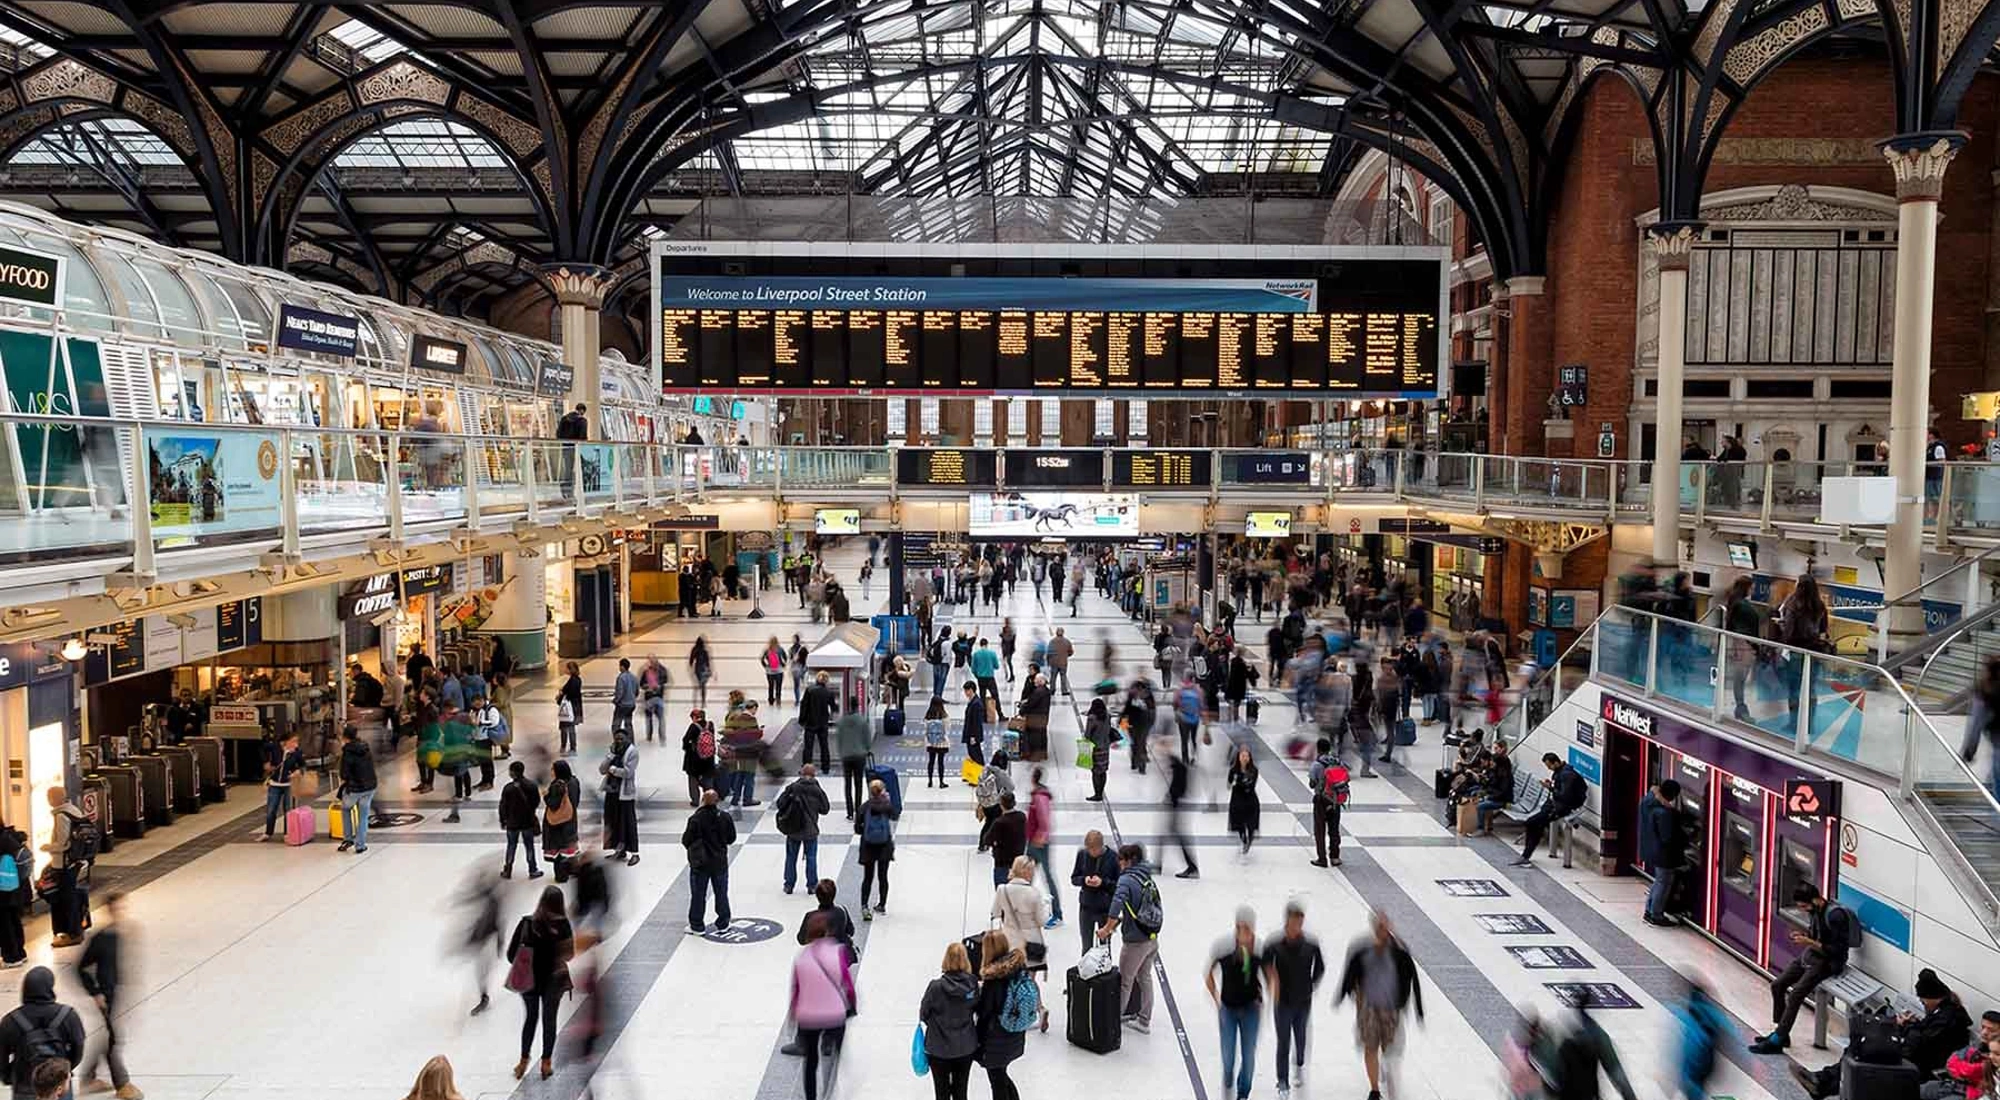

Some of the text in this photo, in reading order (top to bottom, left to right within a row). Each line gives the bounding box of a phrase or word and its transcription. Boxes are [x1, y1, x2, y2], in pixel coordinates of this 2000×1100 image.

[666, 244, 707, 252] Departures
[687, 286, 926, 304] Welcome to Liverpool Street Station
[9, 391, 73, 432] M&S
[1256, 463, 1272, 473] Lift
[365, 574, 391, 593] AMT
[249, 598, 258, 623] 5
[354, 591, 395, 616] COFFEE
[1613, 703, 1651, 736] NatWest
[709, 930, 747, 941] Lift
